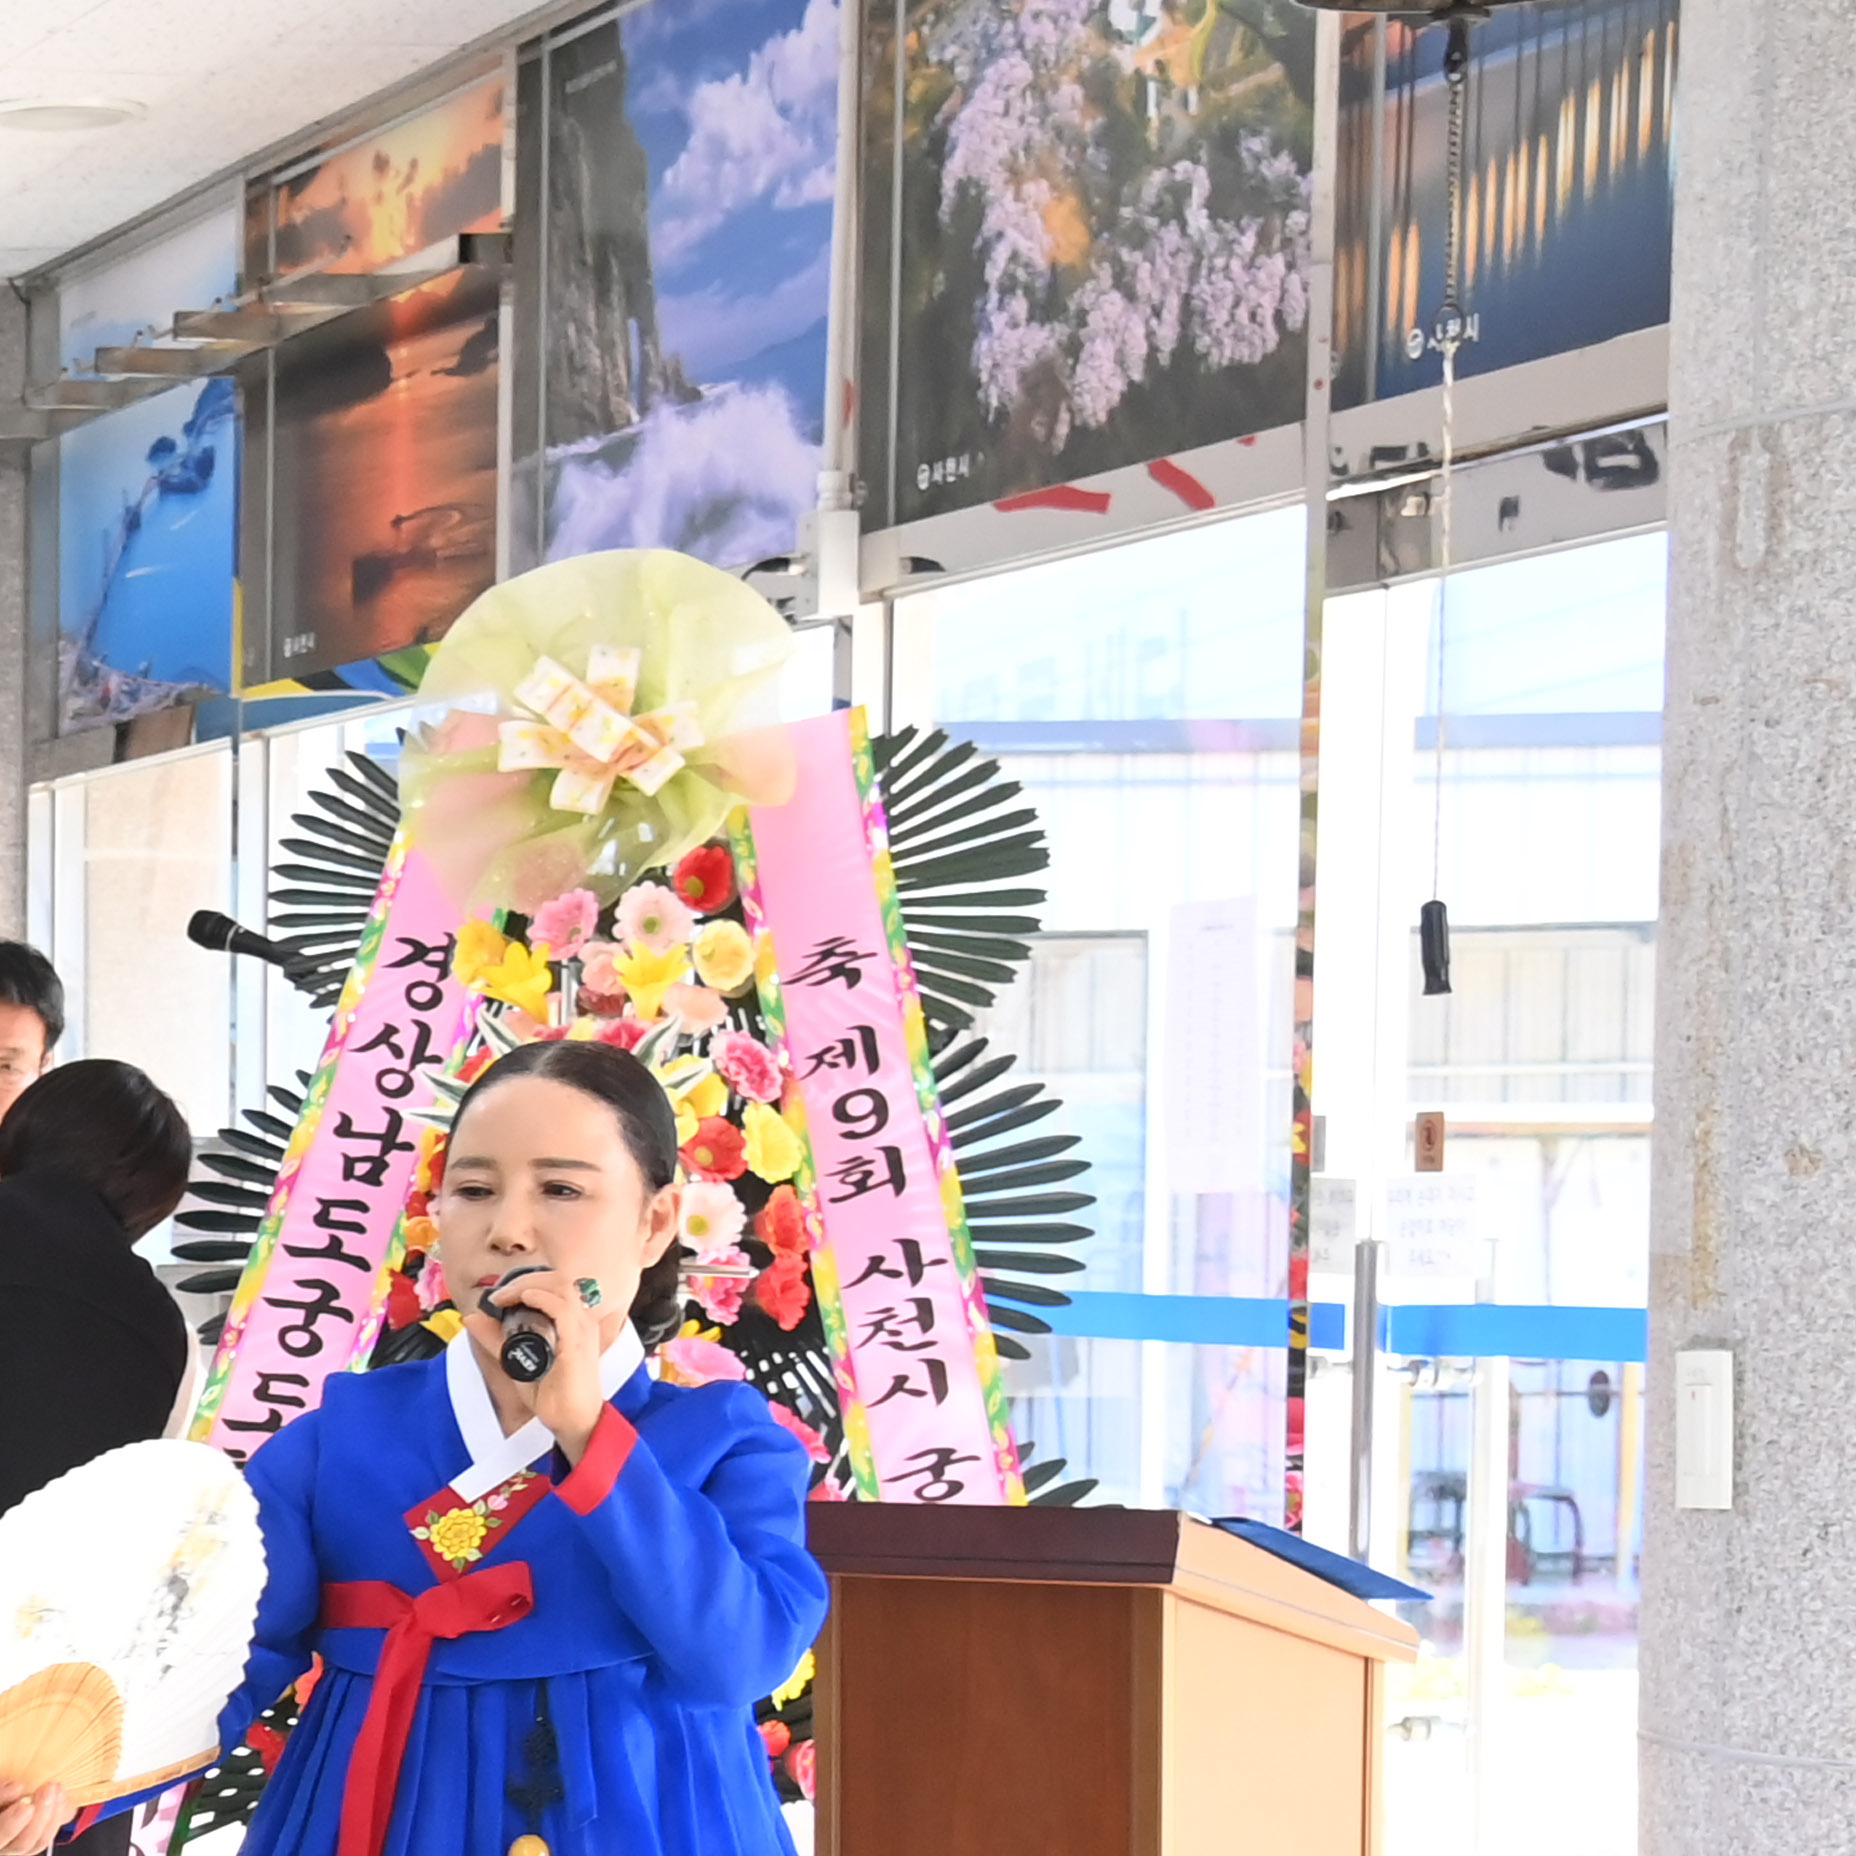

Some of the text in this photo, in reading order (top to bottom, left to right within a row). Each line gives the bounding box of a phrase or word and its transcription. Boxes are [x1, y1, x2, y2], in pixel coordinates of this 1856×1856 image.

[781, 935, 879, 994] 축
[220, 931, 456, 1470] 경상남도궁도
[799, 1024, 910, 1206] 제9회
[841, 1236, 954, 1410] 사천시
